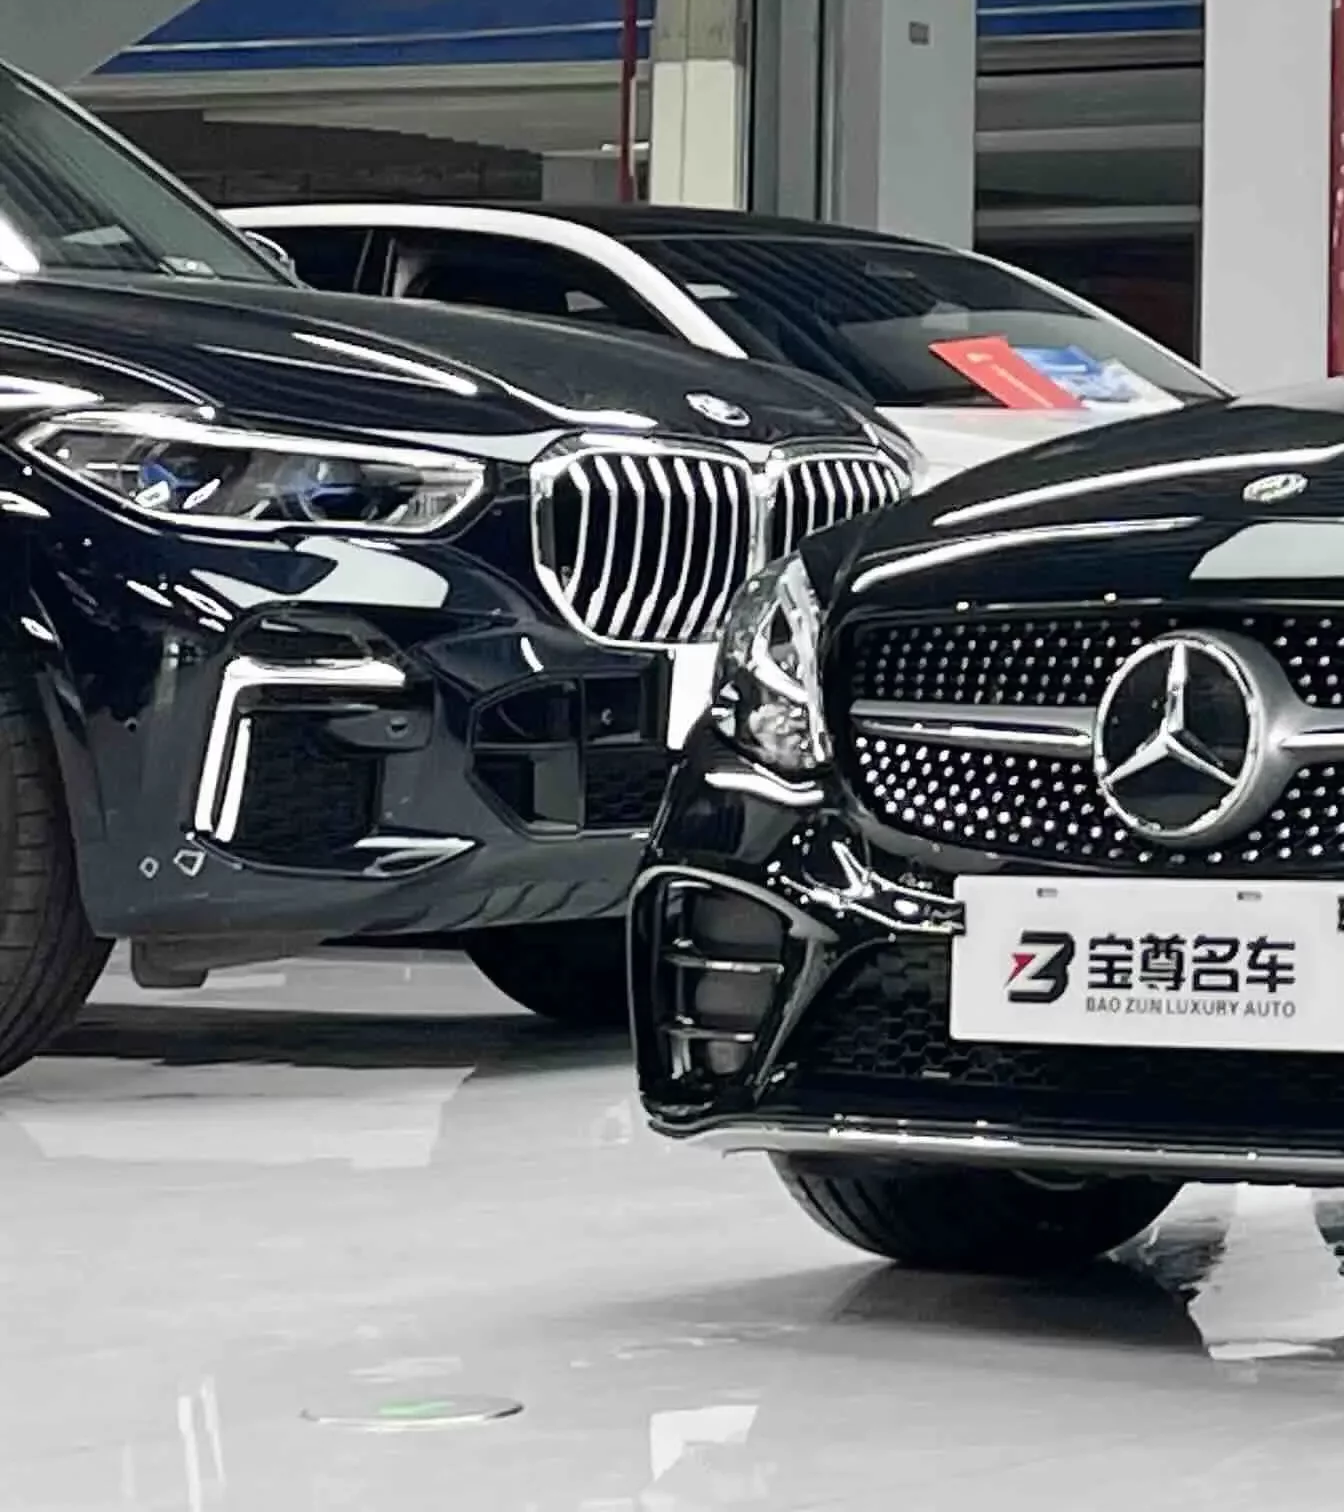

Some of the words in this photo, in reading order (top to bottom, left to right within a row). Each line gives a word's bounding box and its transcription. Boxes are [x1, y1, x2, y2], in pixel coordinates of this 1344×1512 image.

[1087, 932, 1295, 993] 宝尊名车
[1085, 996, 1121, 1013] BAO
[1125, 997, 1163, 1014] ZUN
[1166, 999, 1240, 1016] LUXURY
[1243, 1001, 1297, 1018] AUTO
